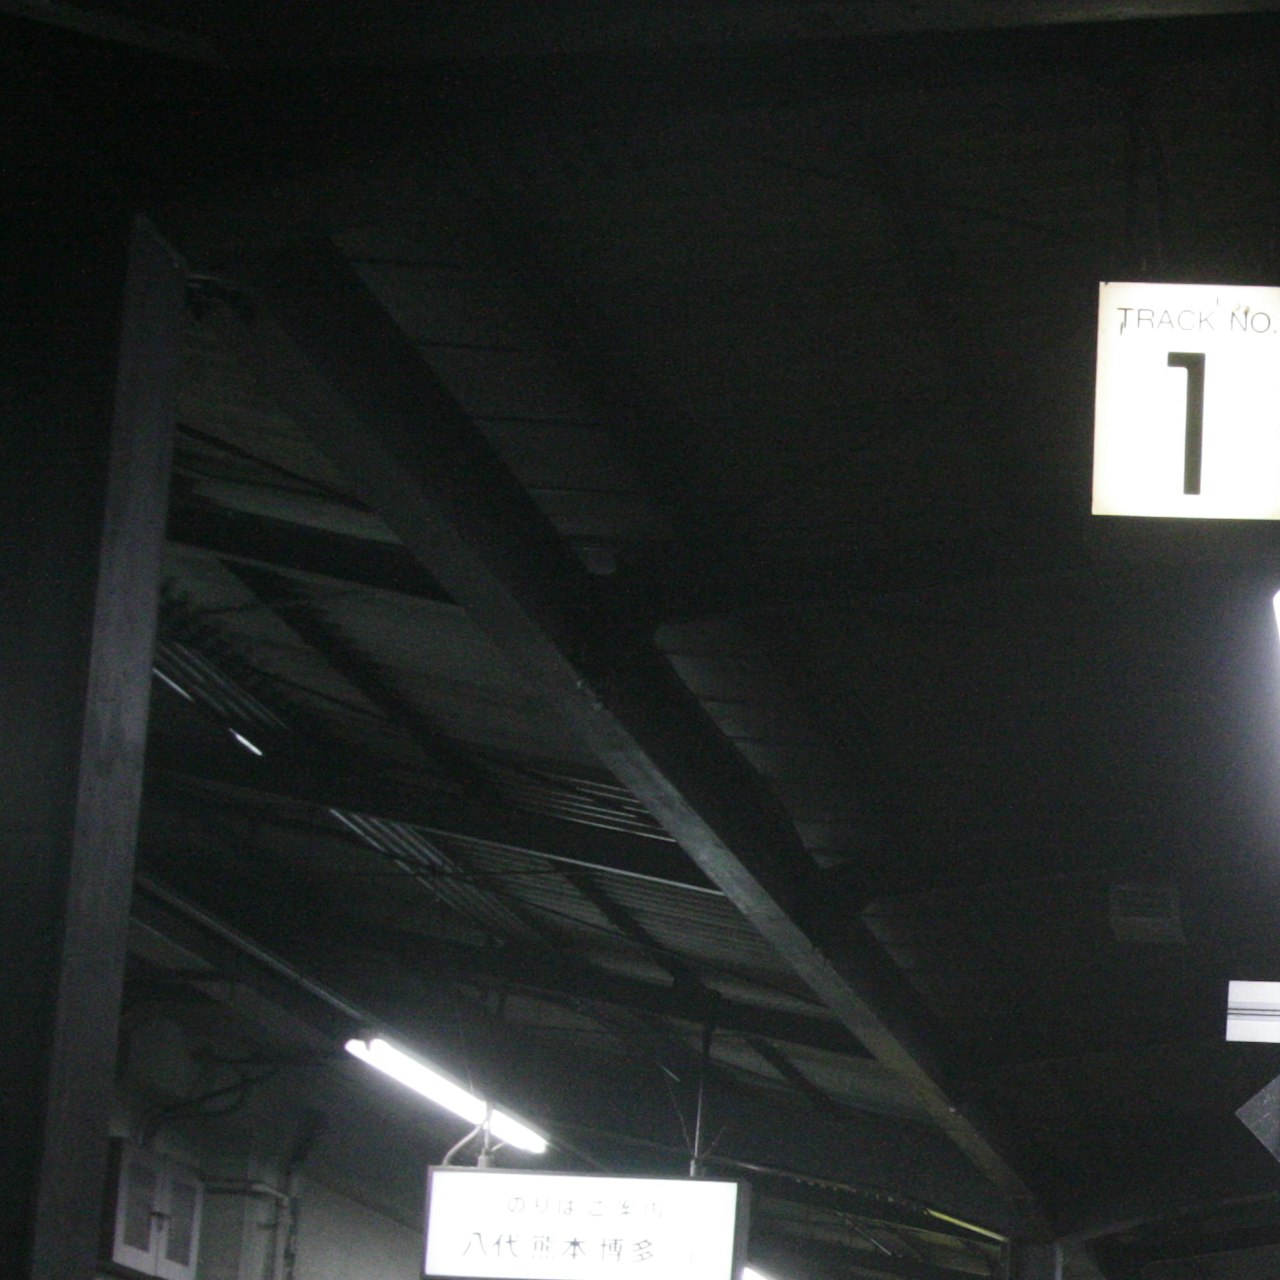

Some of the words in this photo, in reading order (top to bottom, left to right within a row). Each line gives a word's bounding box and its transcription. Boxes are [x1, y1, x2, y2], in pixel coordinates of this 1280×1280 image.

[1117, 307, 1216, 333] TRACK
[1230, 311, 1278, 334] NO.
[1167, 351, 1206, 496] 1
[461, 1231, 521, 1258] 八代
[530, 1234, 587, 1260] 熊本
[599, 1236, 656, 1263] 博多
